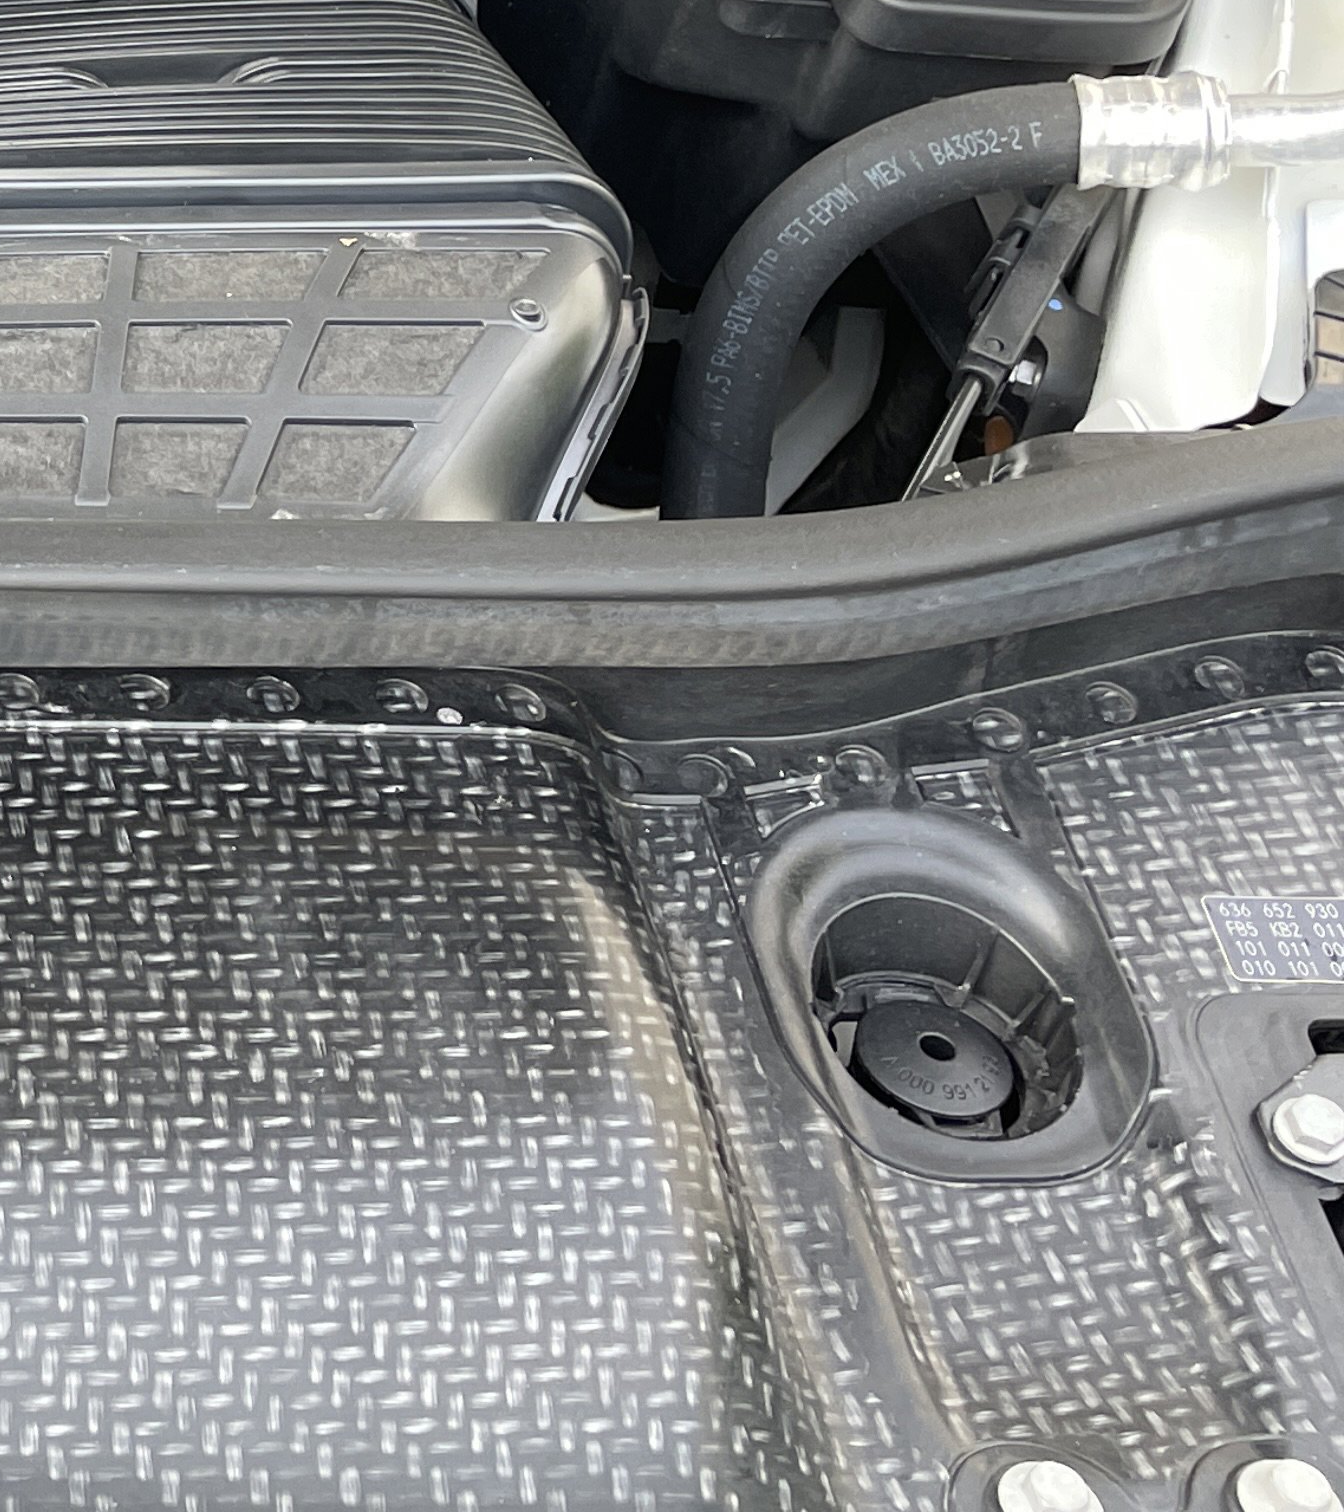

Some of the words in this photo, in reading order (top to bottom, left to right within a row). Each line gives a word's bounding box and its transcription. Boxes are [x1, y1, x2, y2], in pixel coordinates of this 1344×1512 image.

[863, 155, 907, 191] MEX
[927, 125, 1024, 168] BA3052-2
[1028, 121, 1044, 149] F
[1219, 902, 1251, 917] 636
[1263, 902, 1295, 919] 652
[1304, 903, 1339, 919] 930
[1225, 920, 1259, 937] FB5
[1269, 921, 1303, 938] KB2
[1235, 940, 1267, 956] 101
[1277, 941, 1311, 957] 011
[1241, 959, 1276, 976] 010
[1287, 960, 1319, 976] 101
[897, 1067, 936, 1095] 000
